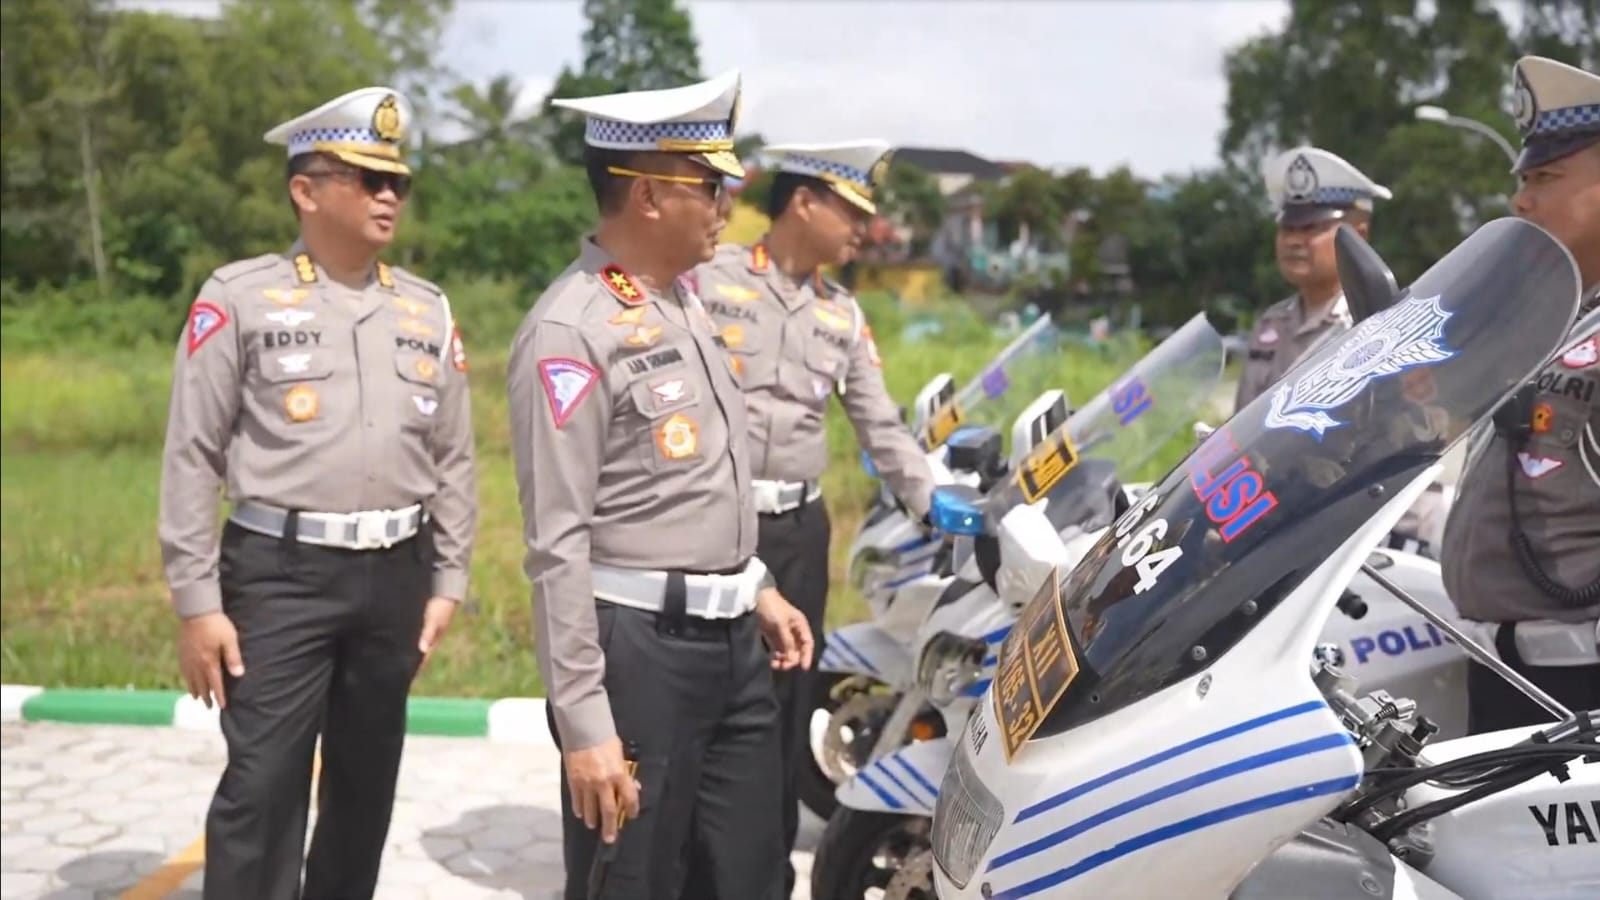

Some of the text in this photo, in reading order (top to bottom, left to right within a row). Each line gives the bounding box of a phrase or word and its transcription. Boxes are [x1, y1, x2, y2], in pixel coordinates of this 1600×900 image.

[263, 330, 322, 349] EDDY
[1535, 371, 1596, 404] OLRI
[1183, 430, 1279, 544] LISI
